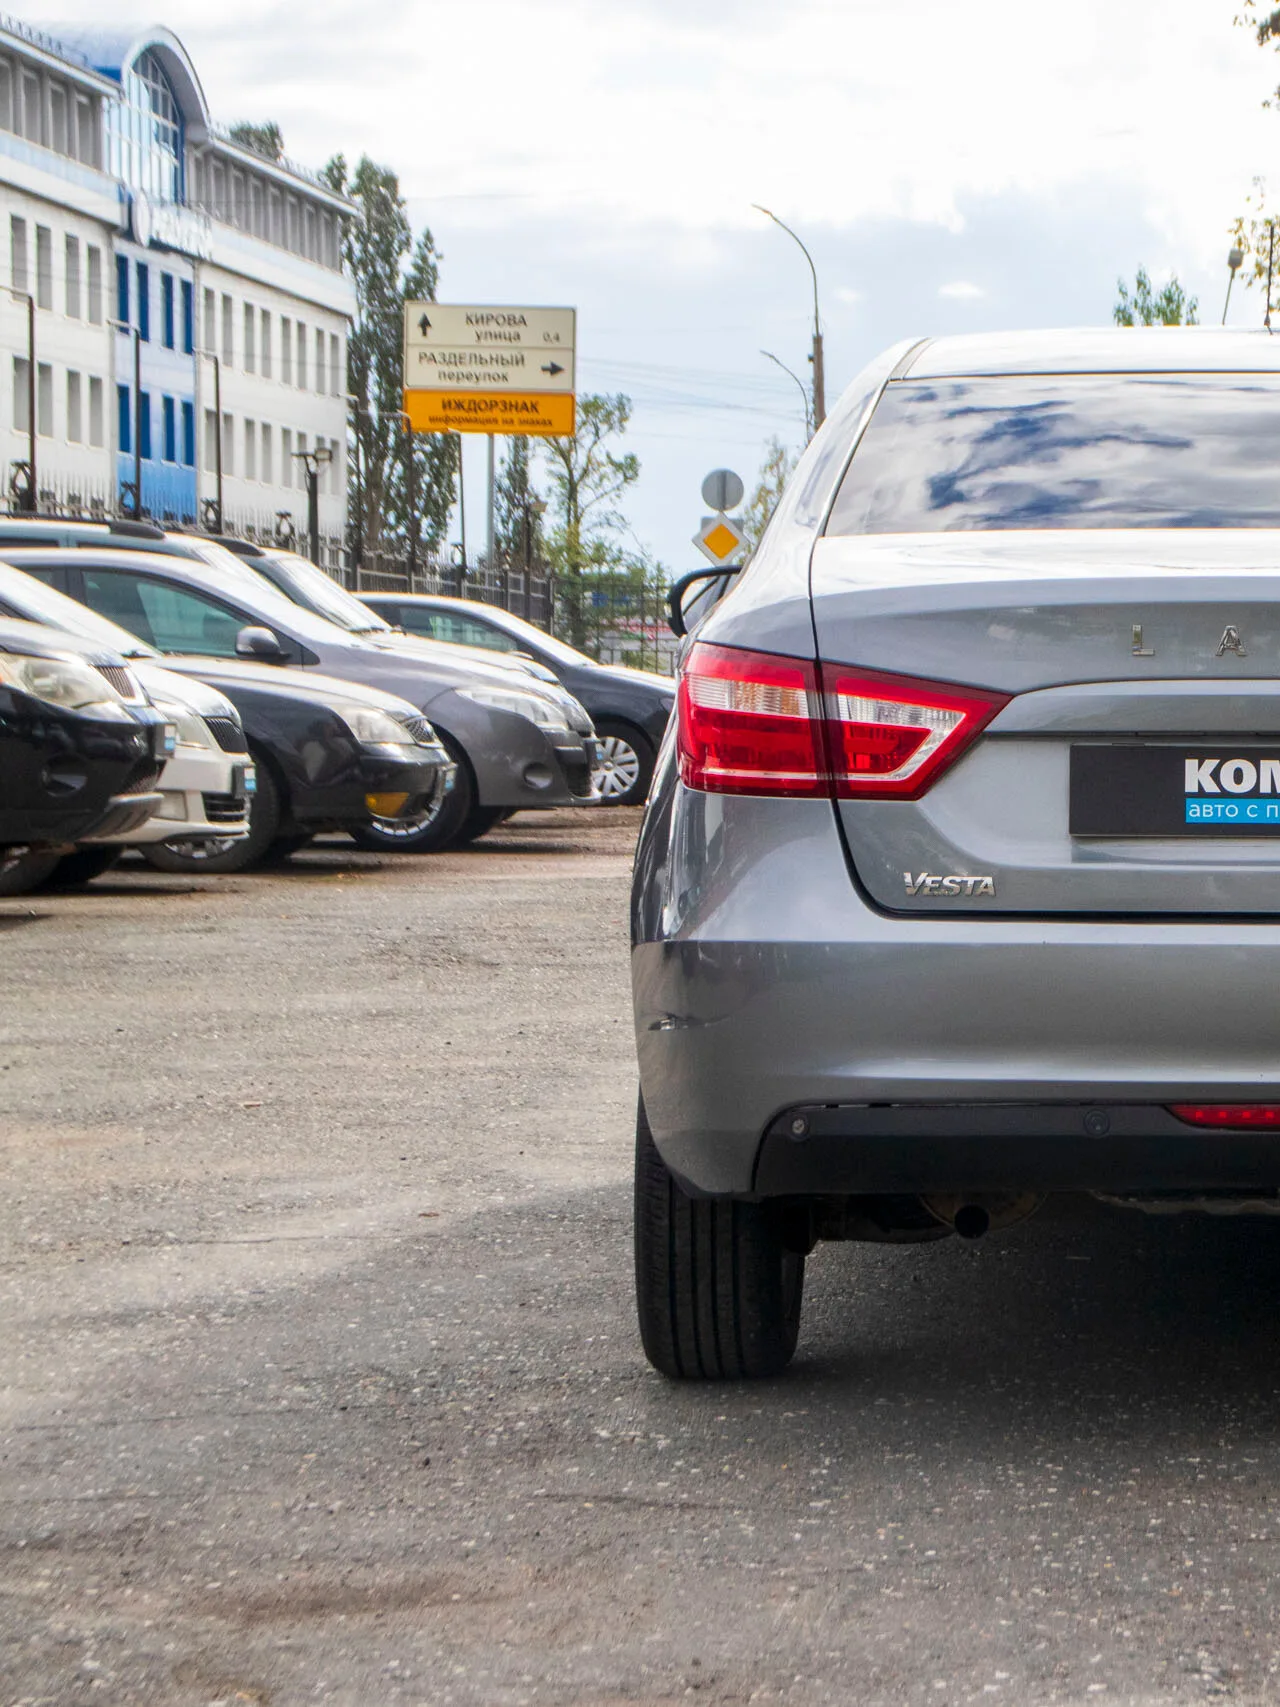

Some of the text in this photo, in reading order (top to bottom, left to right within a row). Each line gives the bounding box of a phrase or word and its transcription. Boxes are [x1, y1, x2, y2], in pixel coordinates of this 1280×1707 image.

[465, 313, 527, 327] КИРОВА
[474, 330, 521, 343] улица
[418, 351, 525, 367] РАЗДЕЛЬНЫЙ
[438, 371, 509, 385] переулок
[441, 399, 539, 414] ИЖДОРЗНАК
[1188, 803, 1239, 818] авто
[1246, 804, 1258, 818] с
[903, 871, 996, 896] VESTA
